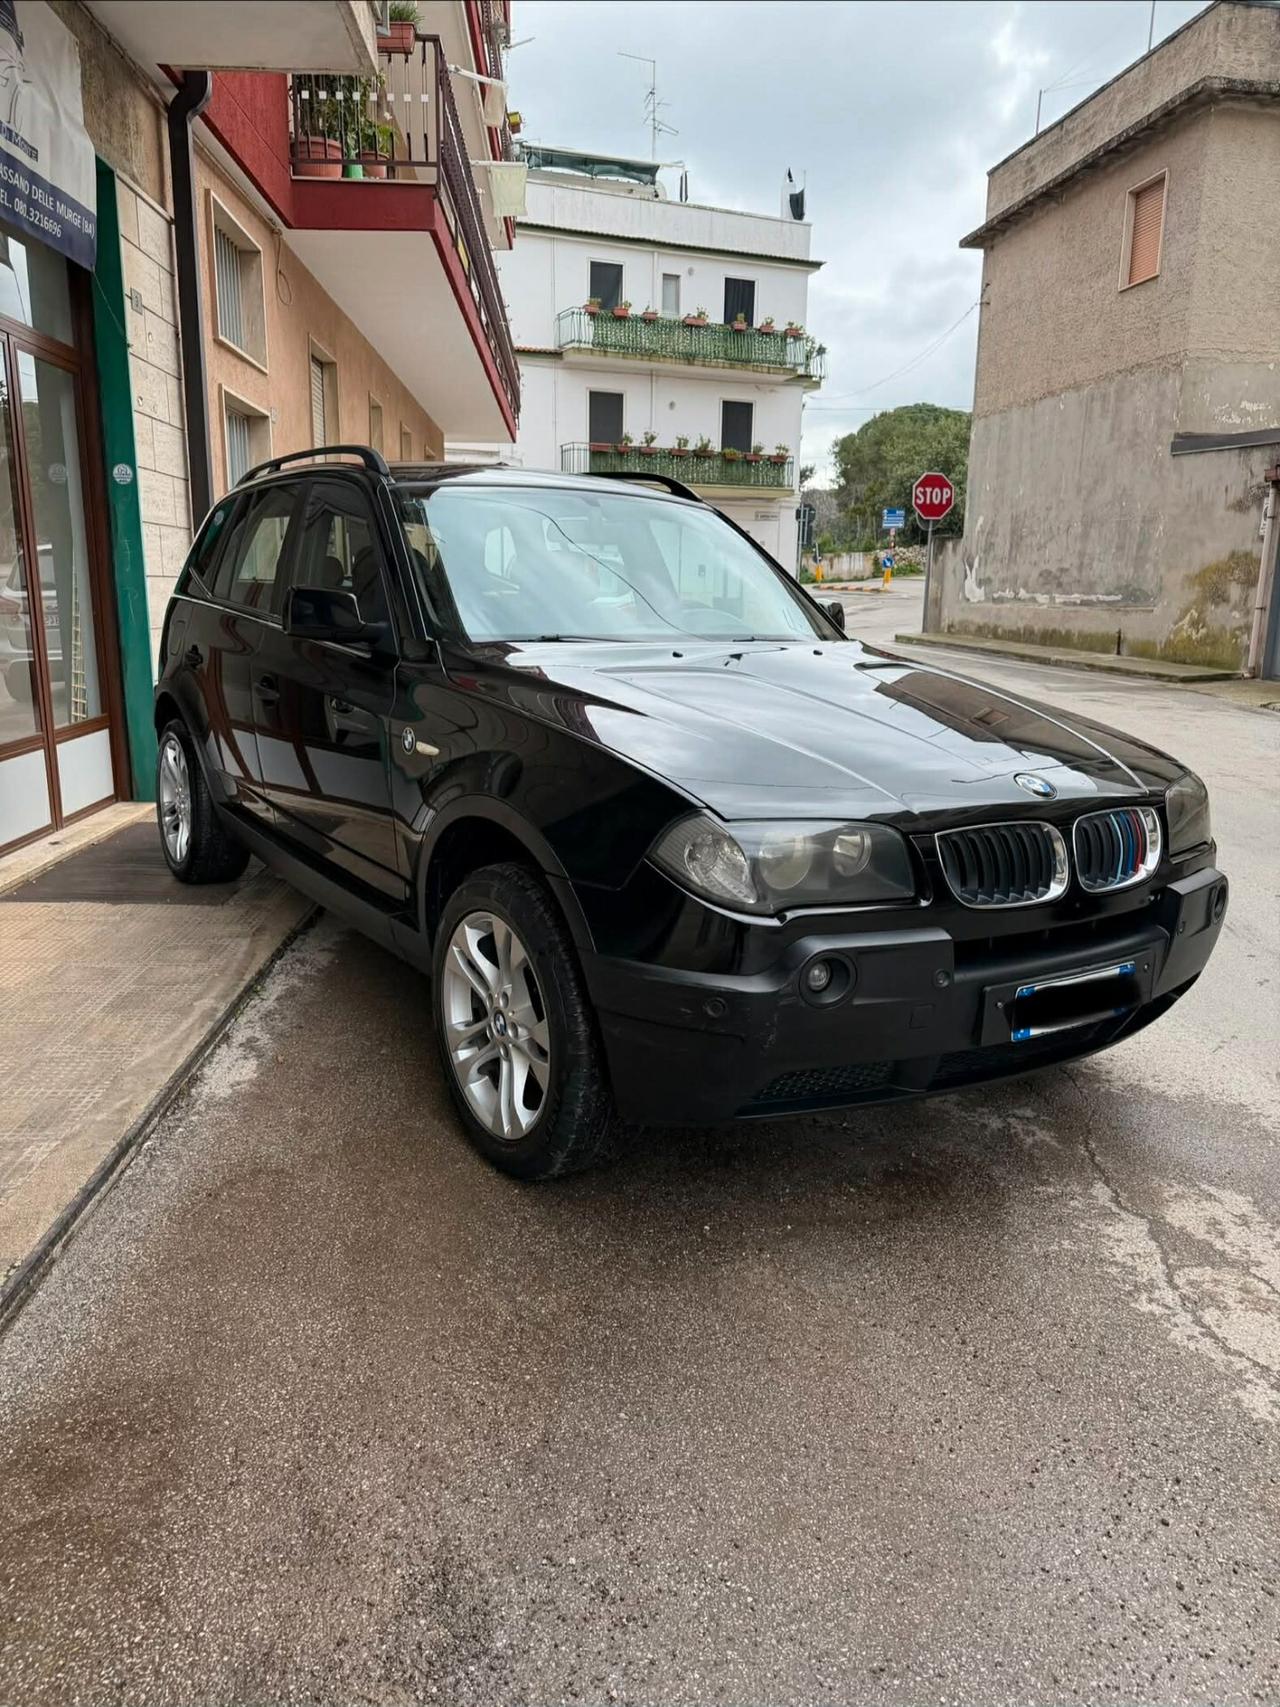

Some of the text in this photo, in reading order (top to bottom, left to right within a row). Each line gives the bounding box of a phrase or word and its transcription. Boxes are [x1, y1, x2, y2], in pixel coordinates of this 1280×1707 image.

[31, 185, 55, 211] DELLE
[56, 200, 81, 229] MURGE
[81, 217, 95, 240] (BA)
[916, 487, 951, 505] STOP
